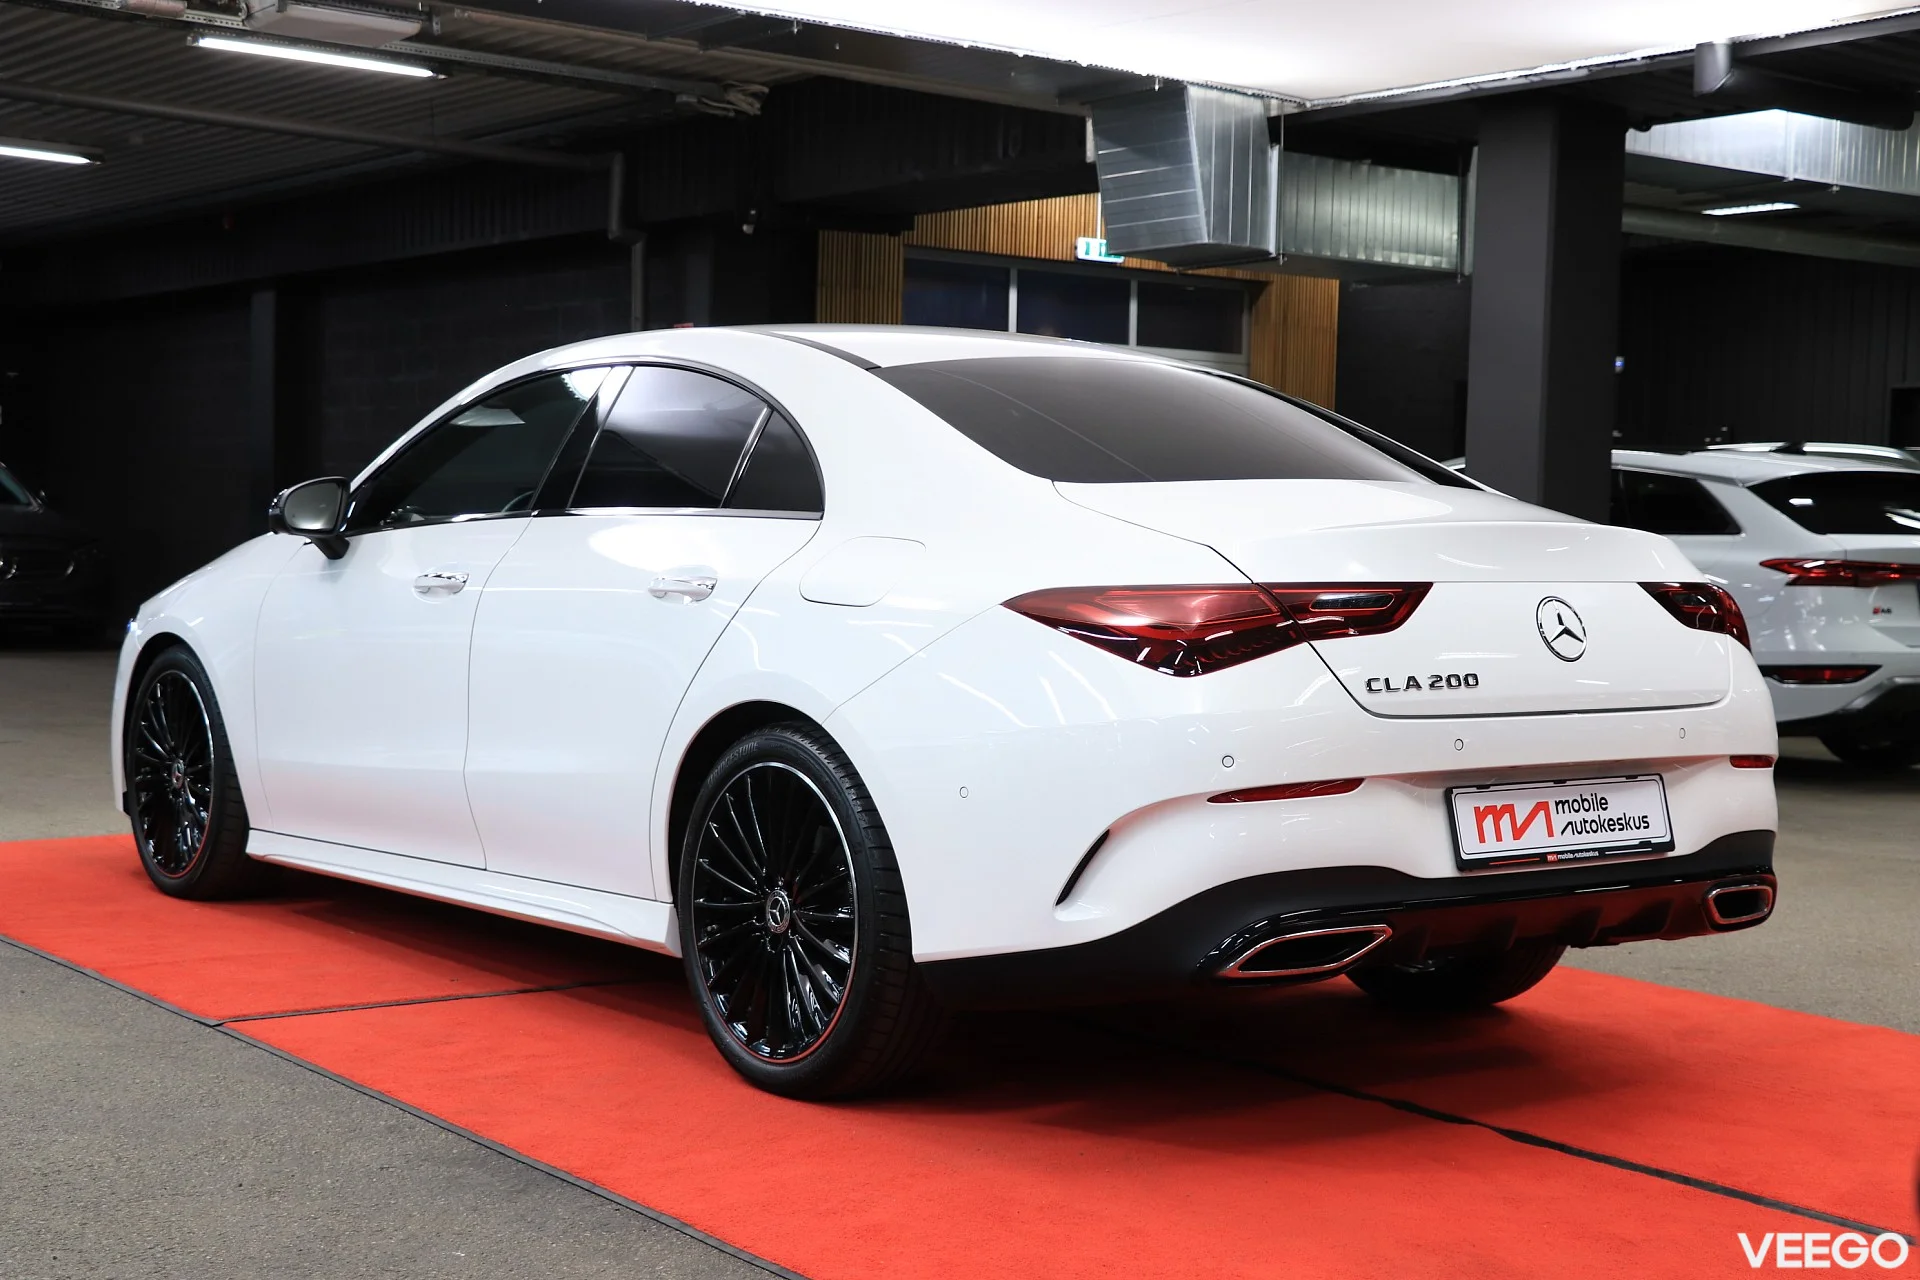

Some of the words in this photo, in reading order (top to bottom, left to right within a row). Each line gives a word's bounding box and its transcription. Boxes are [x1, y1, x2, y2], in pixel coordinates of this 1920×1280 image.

[1365, 676, 1422, 693] CLA
[1428, 673, 1480, 690] 200
[1554, 792, 1609, 815] mobile
